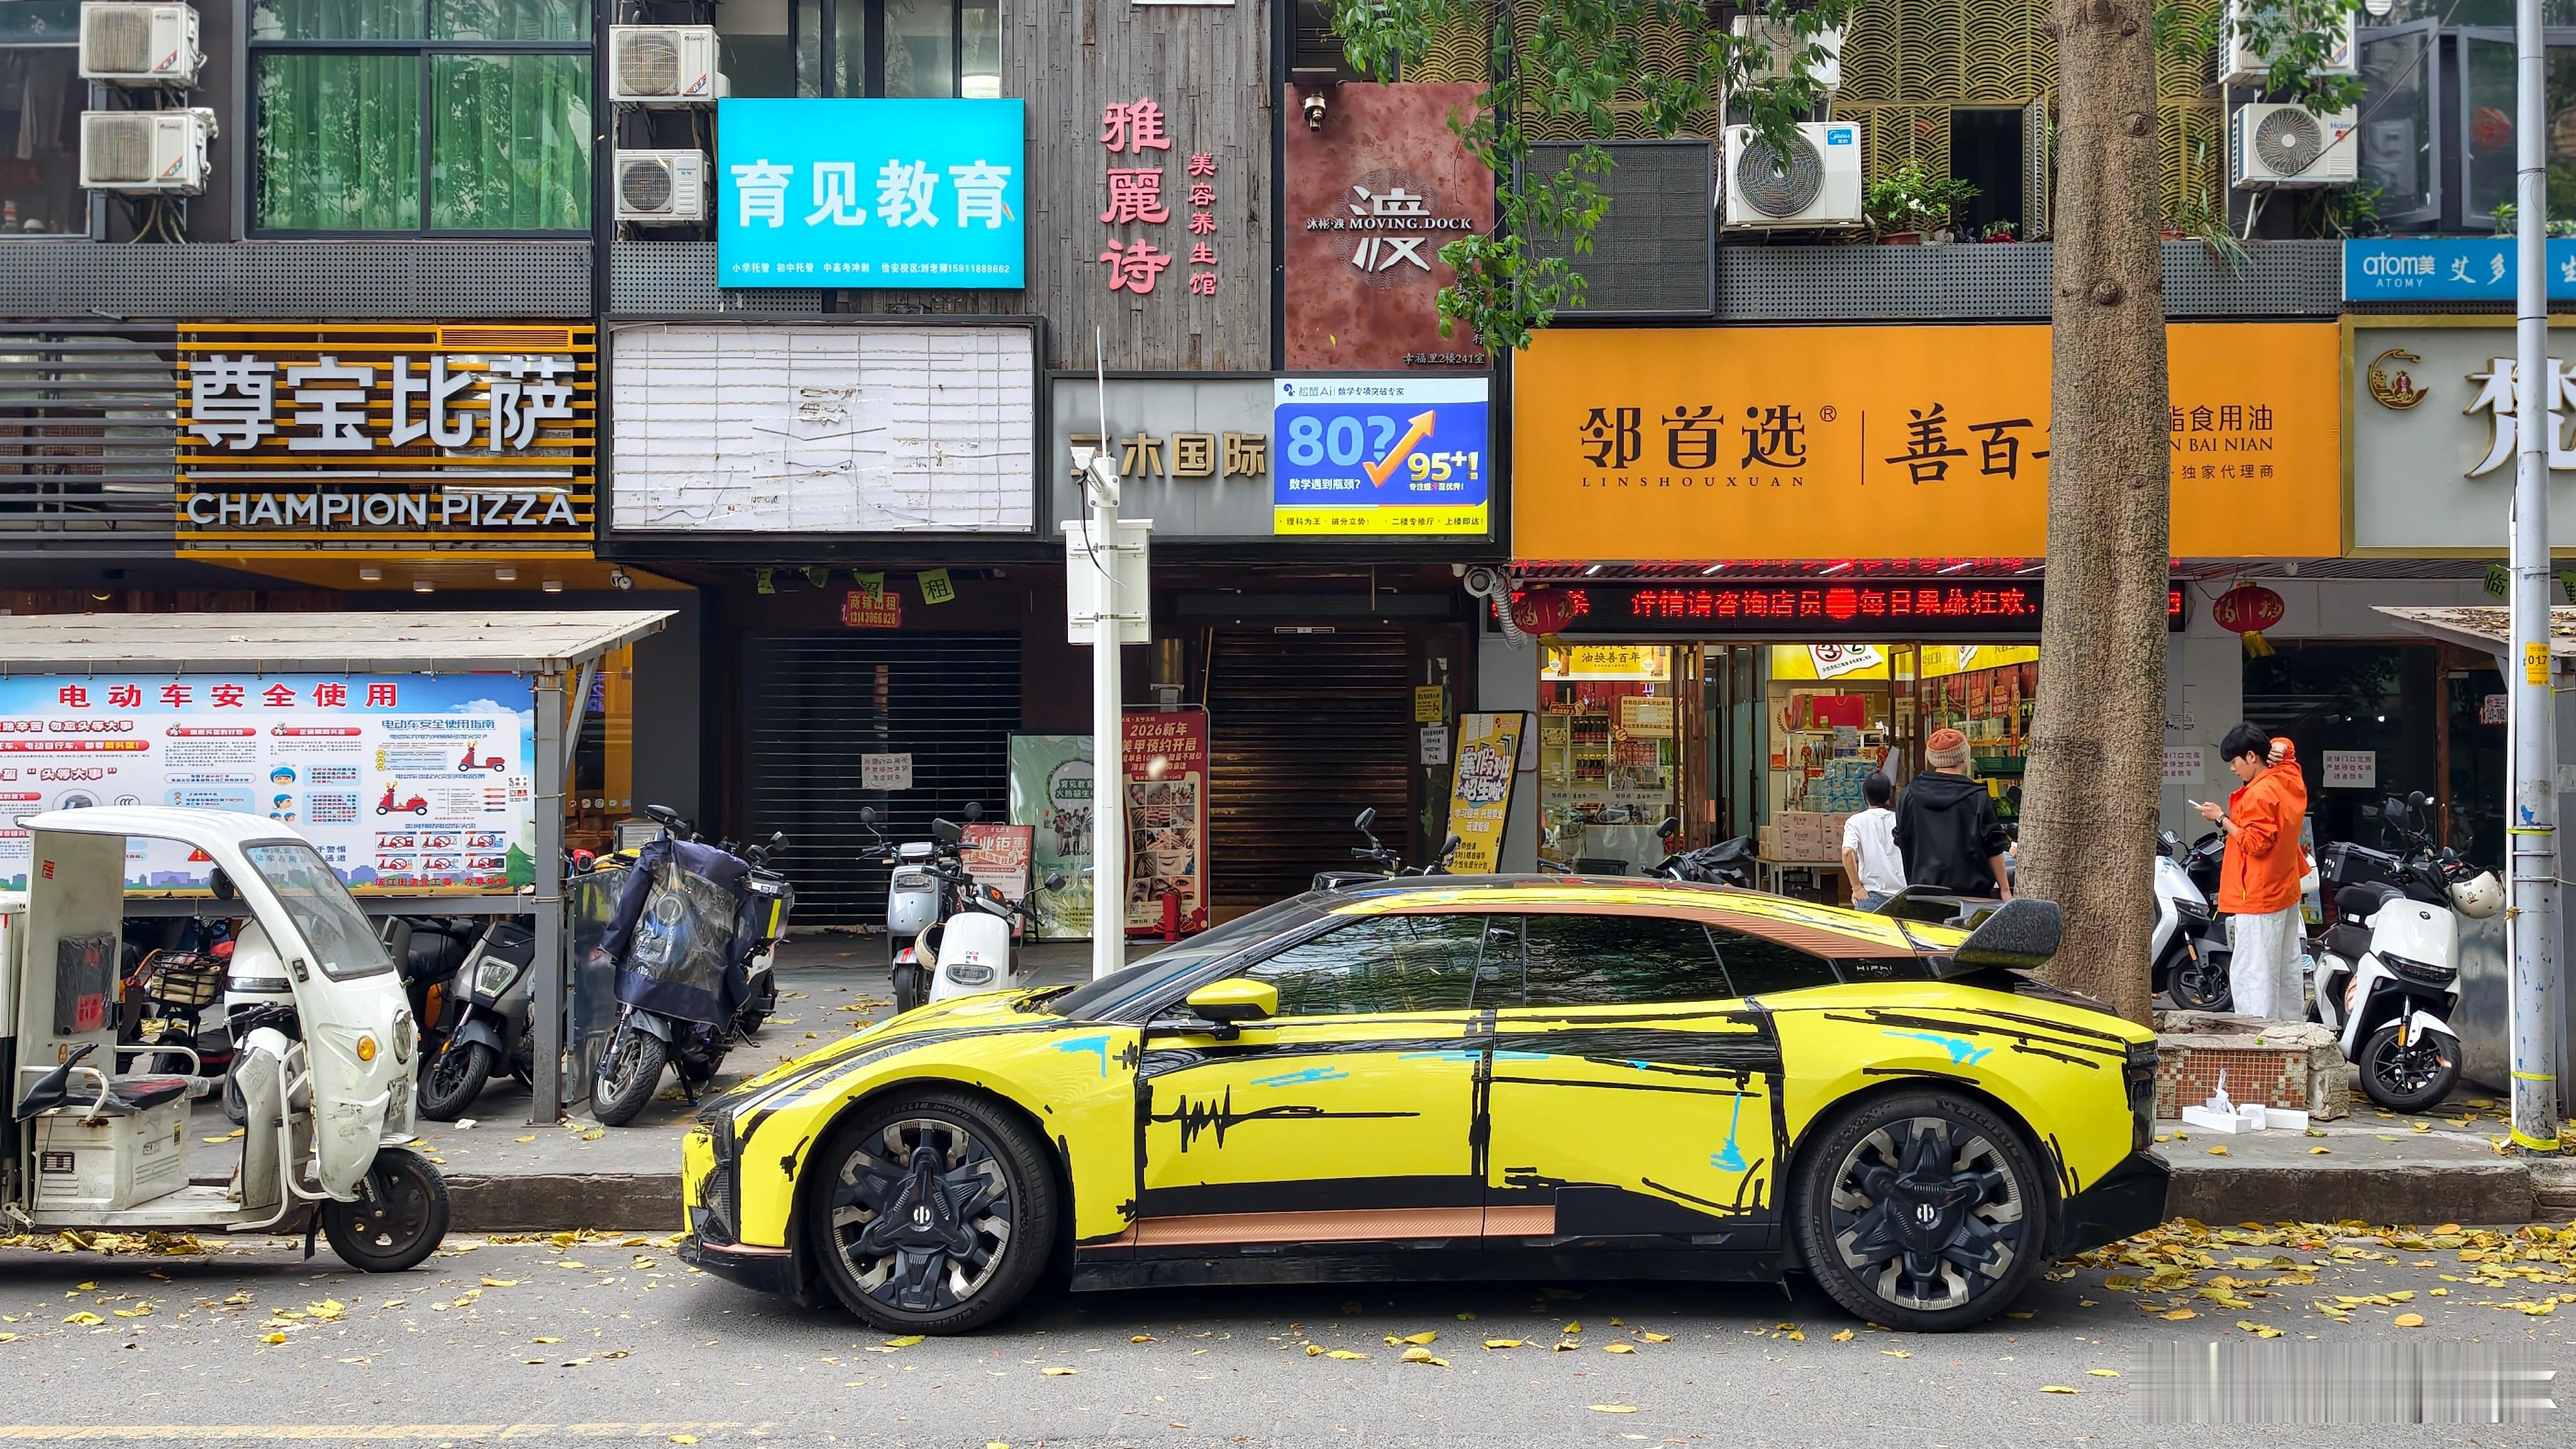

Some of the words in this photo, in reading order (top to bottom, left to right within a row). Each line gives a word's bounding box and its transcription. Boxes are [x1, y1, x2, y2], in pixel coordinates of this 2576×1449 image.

[730, 158, 1012, 229] 育见教育
[1099, 97, 1172, 294] 雅麗诗
[1187, 152, 1218, 297] 美容养生馆
[1349, 218, 1473, 230] MOVING.DOCK
[732, 263, 770, 273] 小学托管
[776, 263, 814, 273] 初中托管
[823, 263, 870, 273] 中高考冲刺
[2363, 252, 2436, 275] atom美
[2377, 278, 2423, 287] ATOMY
[1404, 352, 1484, 364] 幸福里2楼241室
[1338, 387, 1404, 396] 数学专项突破专家
[187, 353, 576, 452] 尊宝比萨
[1287, 414, 1396, 467] 80?
[1579, 404, 1807, 470] 邻首选
[2189, 436, 2218, 452] BAI
[2224, 436, 2273, 452] NIAN
[2182, 464, 2275, 480] 独家代理商
[1582, 476, 1804, 487] LINSHOUXUAN
[187, 492, 428, 526] CHAMPION
[441, 492, 579, 526] PIZZA
[1286, 518, 1321, 526] 理科为王
[1391, 518, 1434, 526] 二楼专修厅
[925, 578, 952, 600] 租
[850, 596, 896, 611] 商铺出租
[1632, 589, 1821, 618] 详情请咨询店员
[1581, 651, 1641, 663] 油换善百年
[58, 683, 397, 709] 电动车安全使用
[0, 721, 43, 733] 路辛苦
[49, 721, 134, 733] 勿忘头等大事
[381, 719, 496, 730] 电动车安全使用指南
[1130, 721, 1188, 736] 2026新年
[1123, 738, 1197, 753] 美甲预约开启
